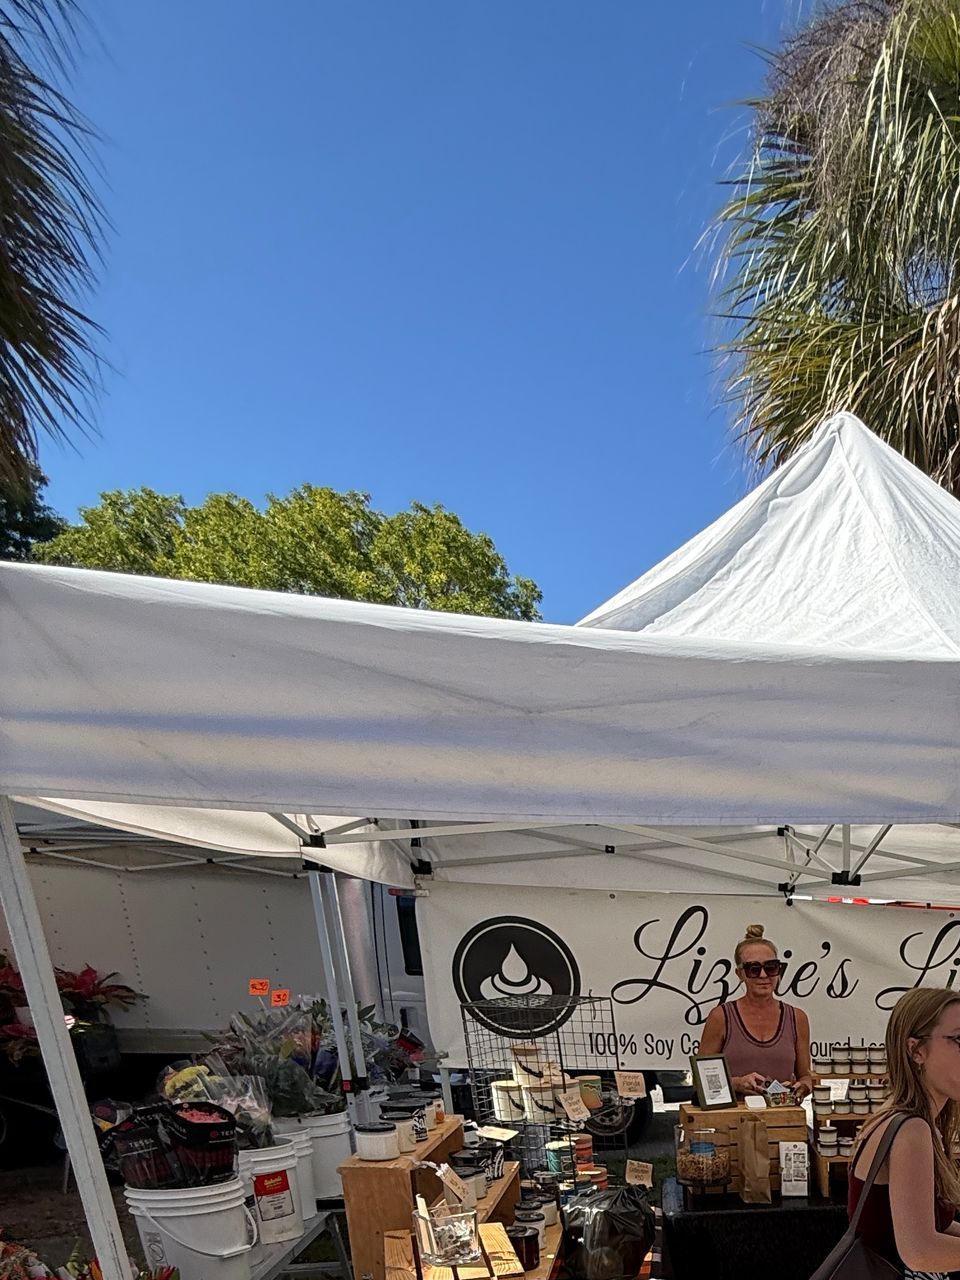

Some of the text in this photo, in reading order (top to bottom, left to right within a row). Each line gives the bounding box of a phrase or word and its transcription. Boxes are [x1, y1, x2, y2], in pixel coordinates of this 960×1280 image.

[611, 905, 859, 1025] Lizie's
[588, 1033, 637, 1056] 100%
[644, 1033, 674, 1061] Soy
